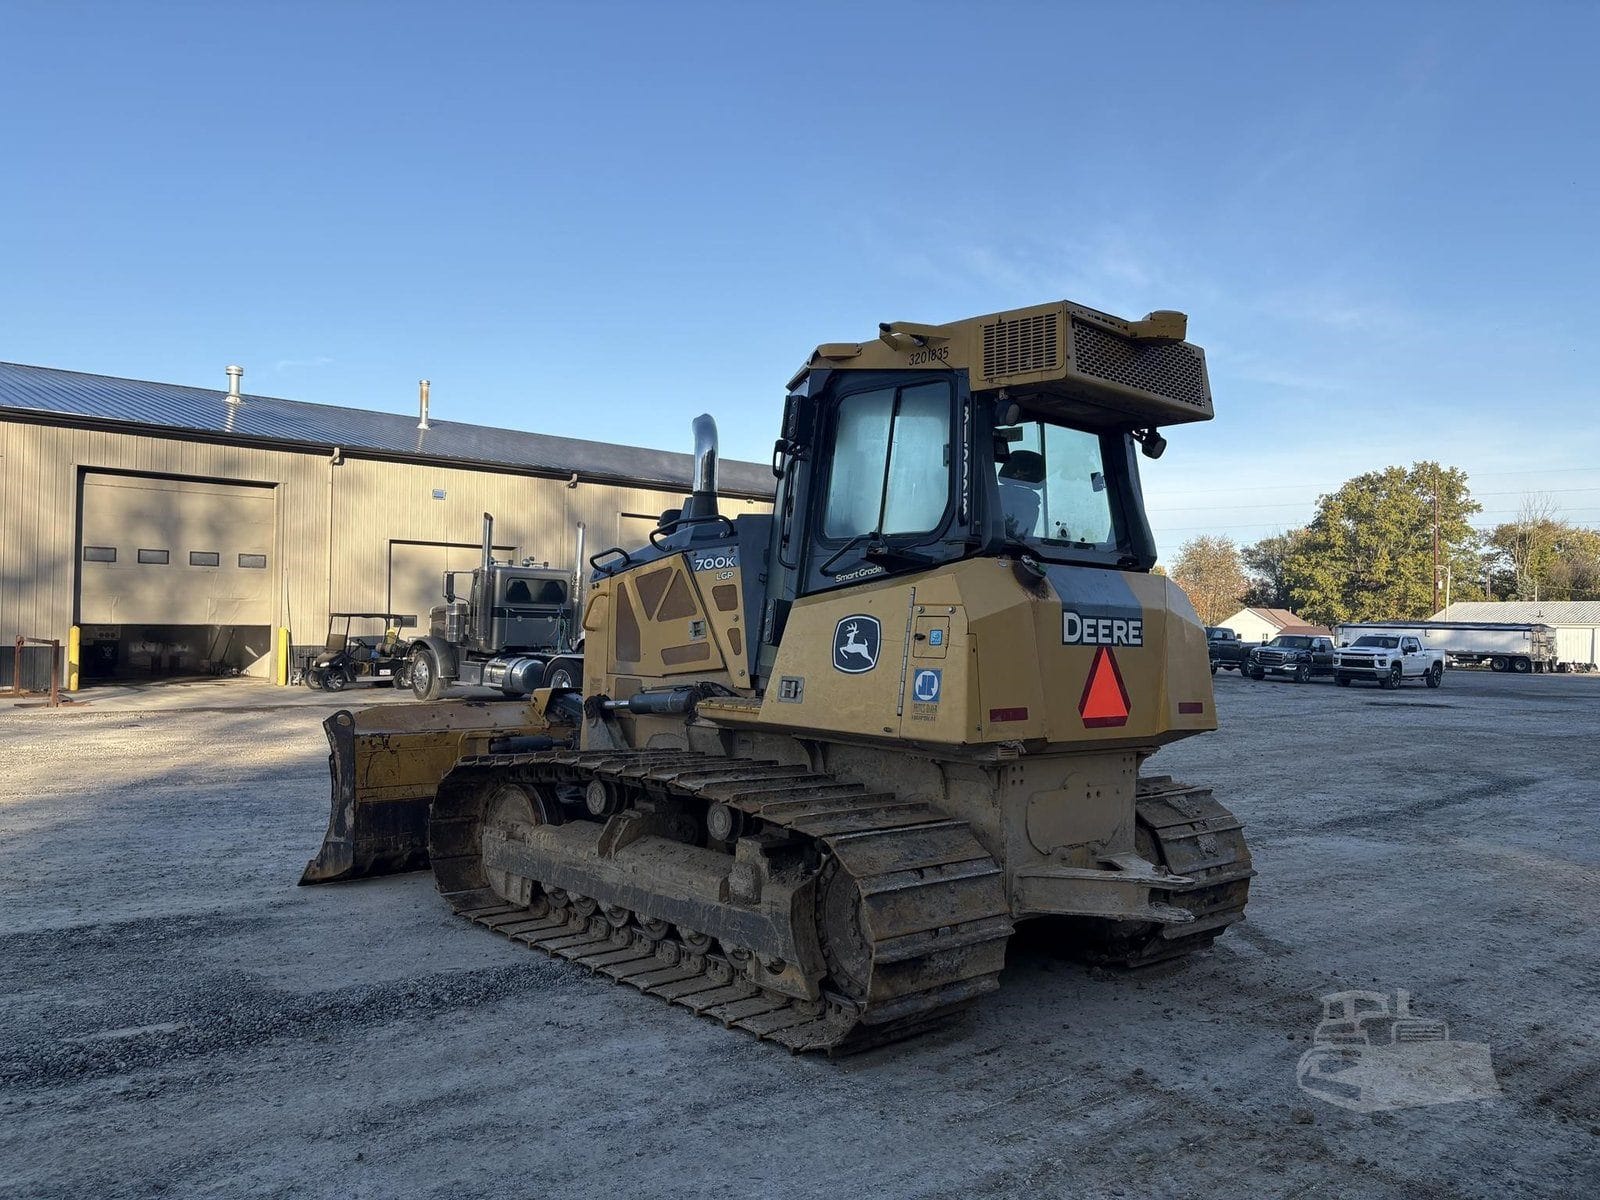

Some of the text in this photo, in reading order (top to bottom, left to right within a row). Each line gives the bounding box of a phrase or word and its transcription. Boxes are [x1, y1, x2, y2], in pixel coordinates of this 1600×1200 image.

[909, 346, 949, 366] 3201835
[695, 556, 735, 571] 700K
[716, 571, 734, 580] LGP
[1063, 611, 1142, 645] DEERE
